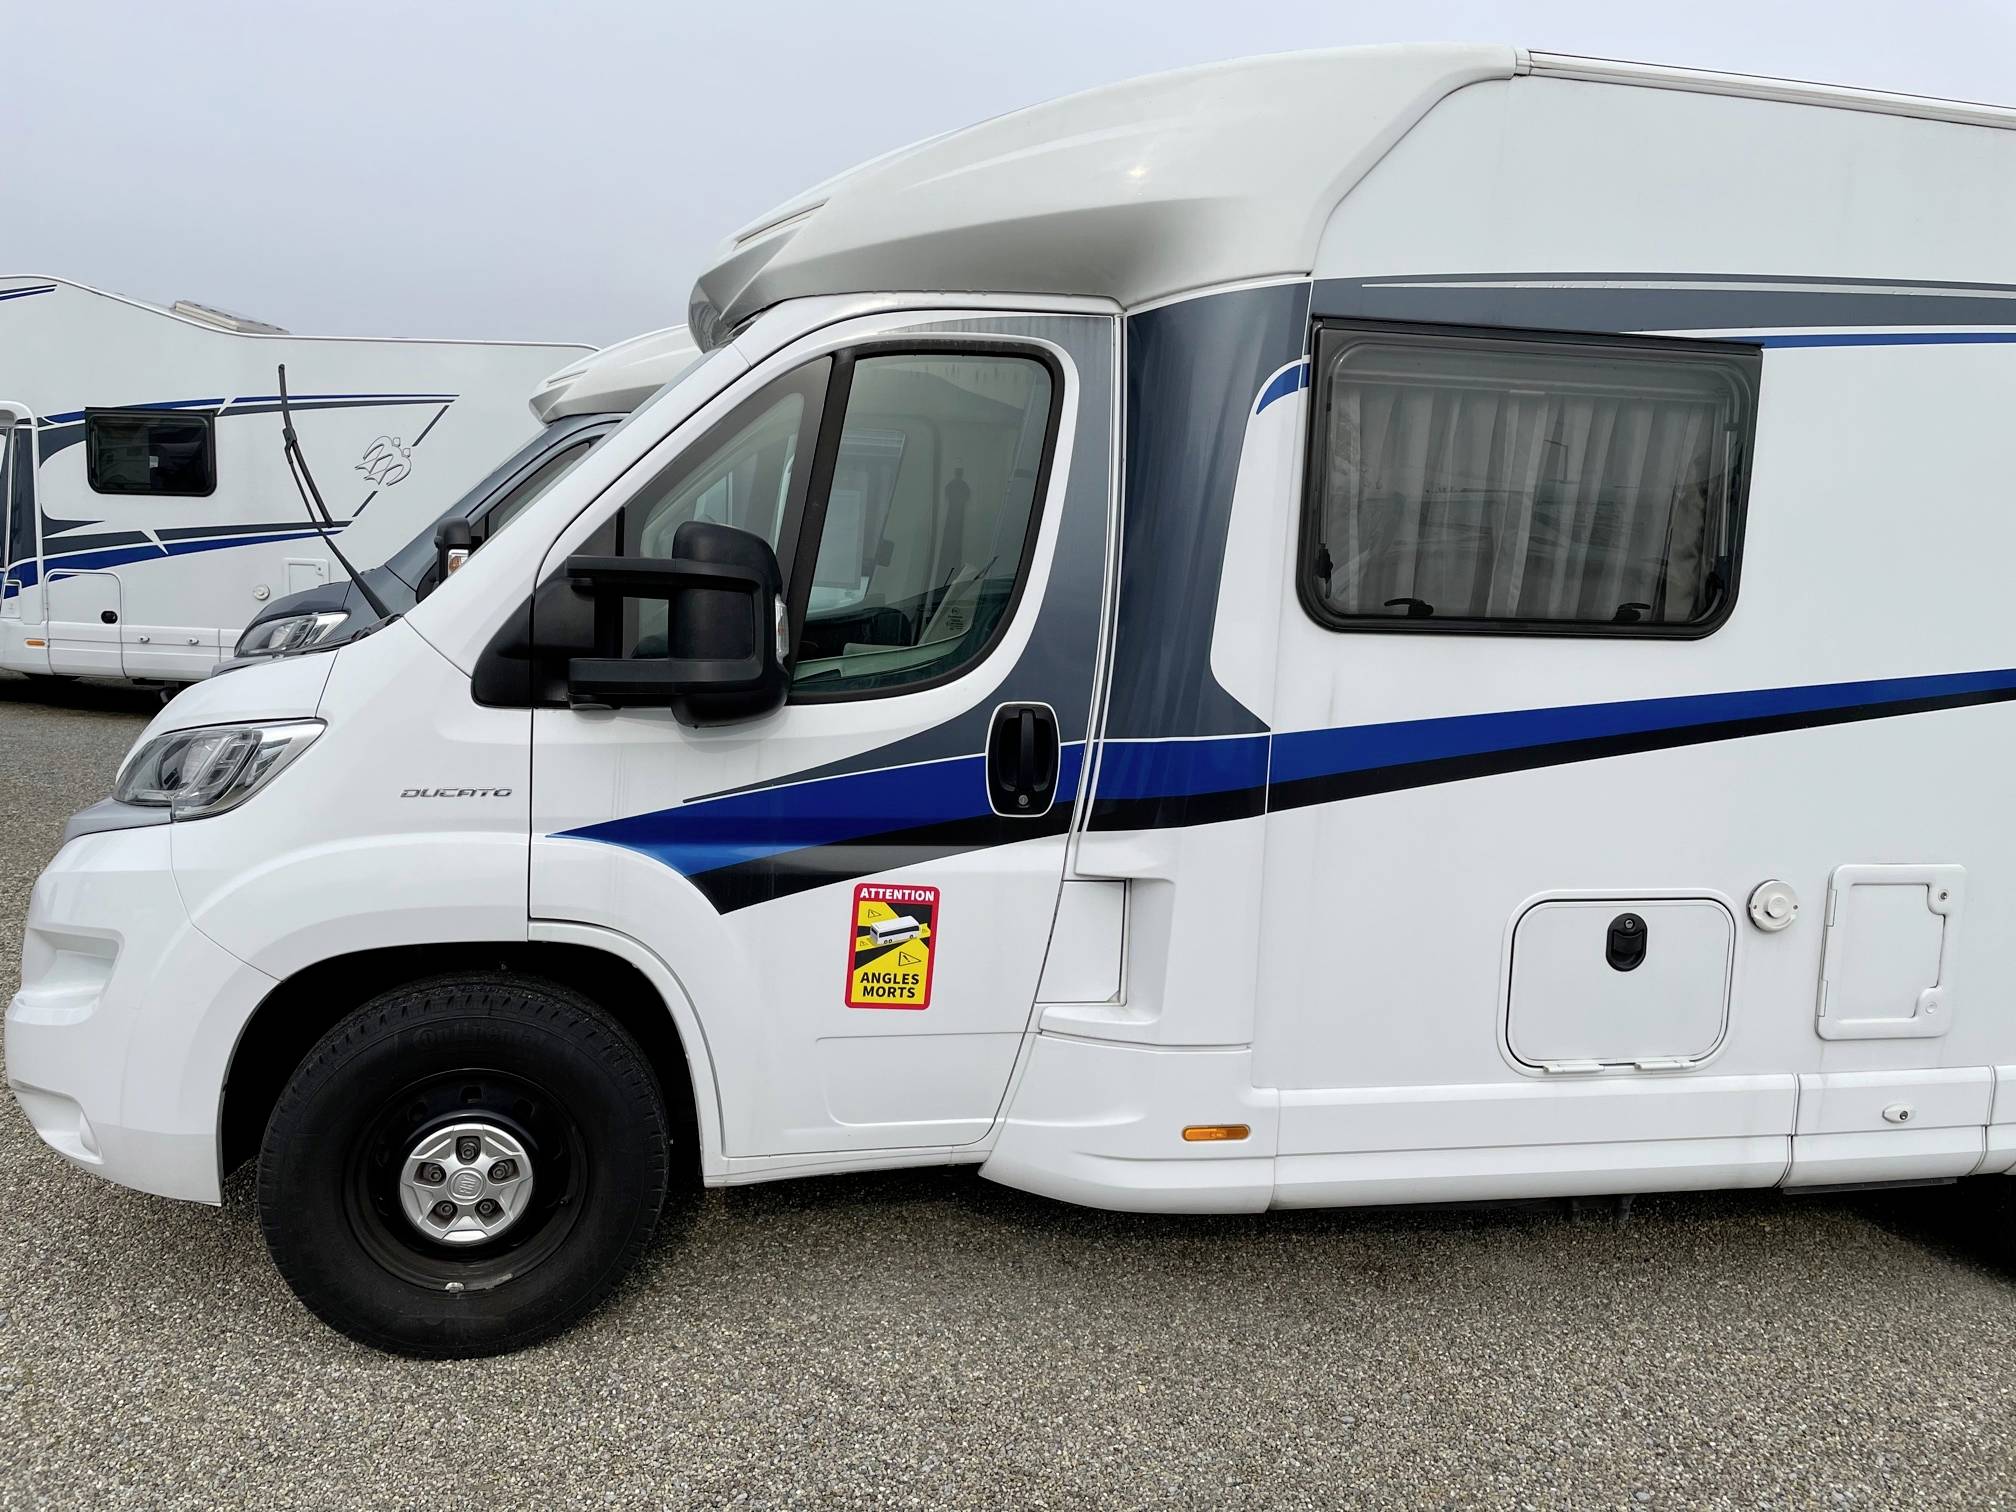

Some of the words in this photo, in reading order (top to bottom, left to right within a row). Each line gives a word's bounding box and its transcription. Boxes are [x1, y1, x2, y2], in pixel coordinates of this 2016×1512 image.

[400, 788, 513, 798] DUCATO
[860, 887, 935, 901] ATTENTION
[860, 972, 920, 985] ANGLES
[863, 985, 916, 998] MORTS
